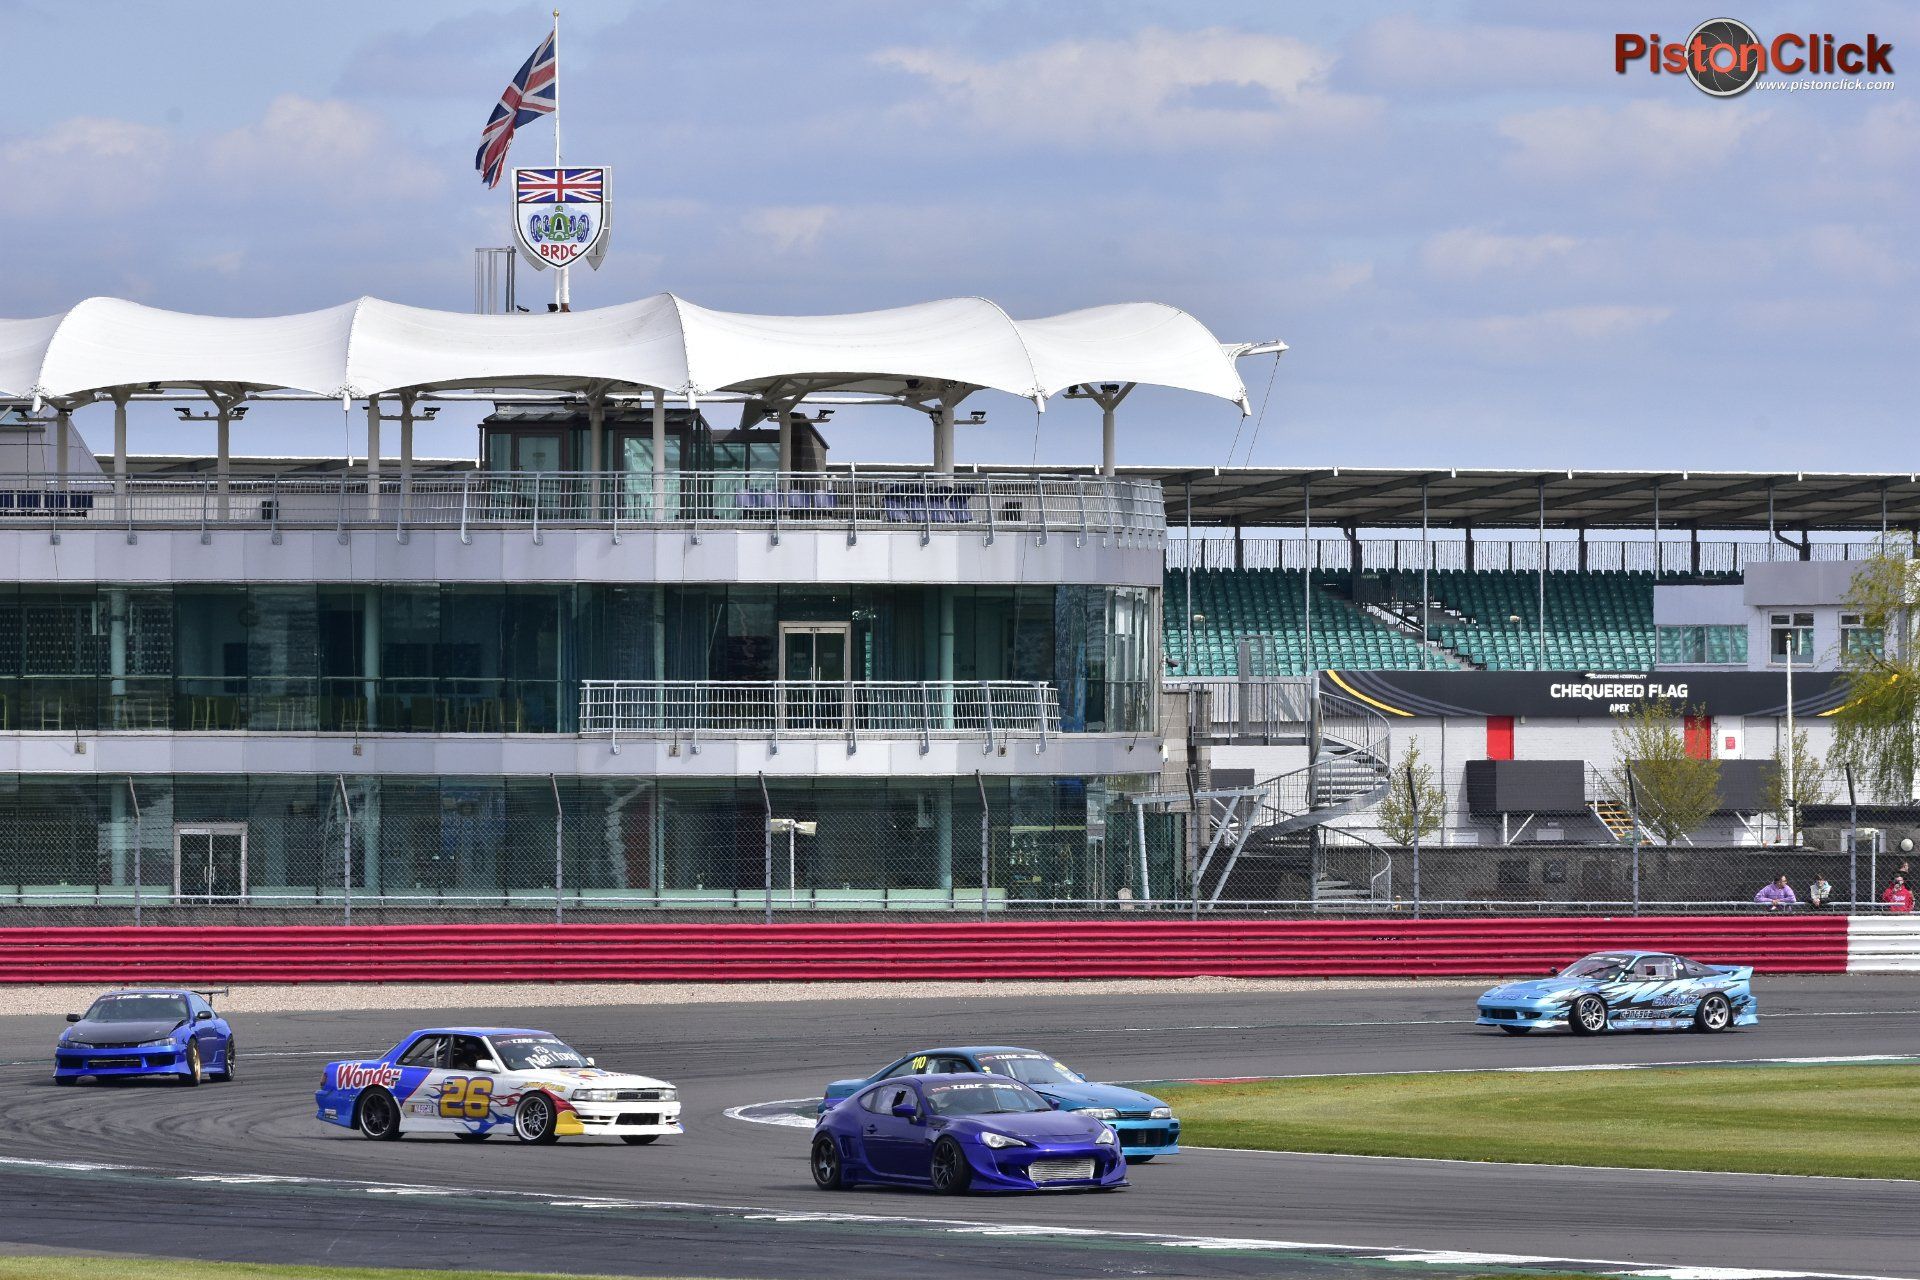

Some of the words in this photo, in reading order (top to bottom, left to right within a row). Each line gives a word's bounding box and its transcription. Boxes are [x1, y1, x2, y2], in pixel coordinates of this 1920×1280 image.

[541, 244, 578, 260] BRDC
[1550, 684, 1645, 700] CHEQUERED
[1648, 684, 1688, 698] FLAG
[1609, 703, 1630, 713] APEX
[912, 1056, 926, 1069] 110
[336, 1061, 402, 1090] Wonder
[439, 1076, 494, 1118] 26
